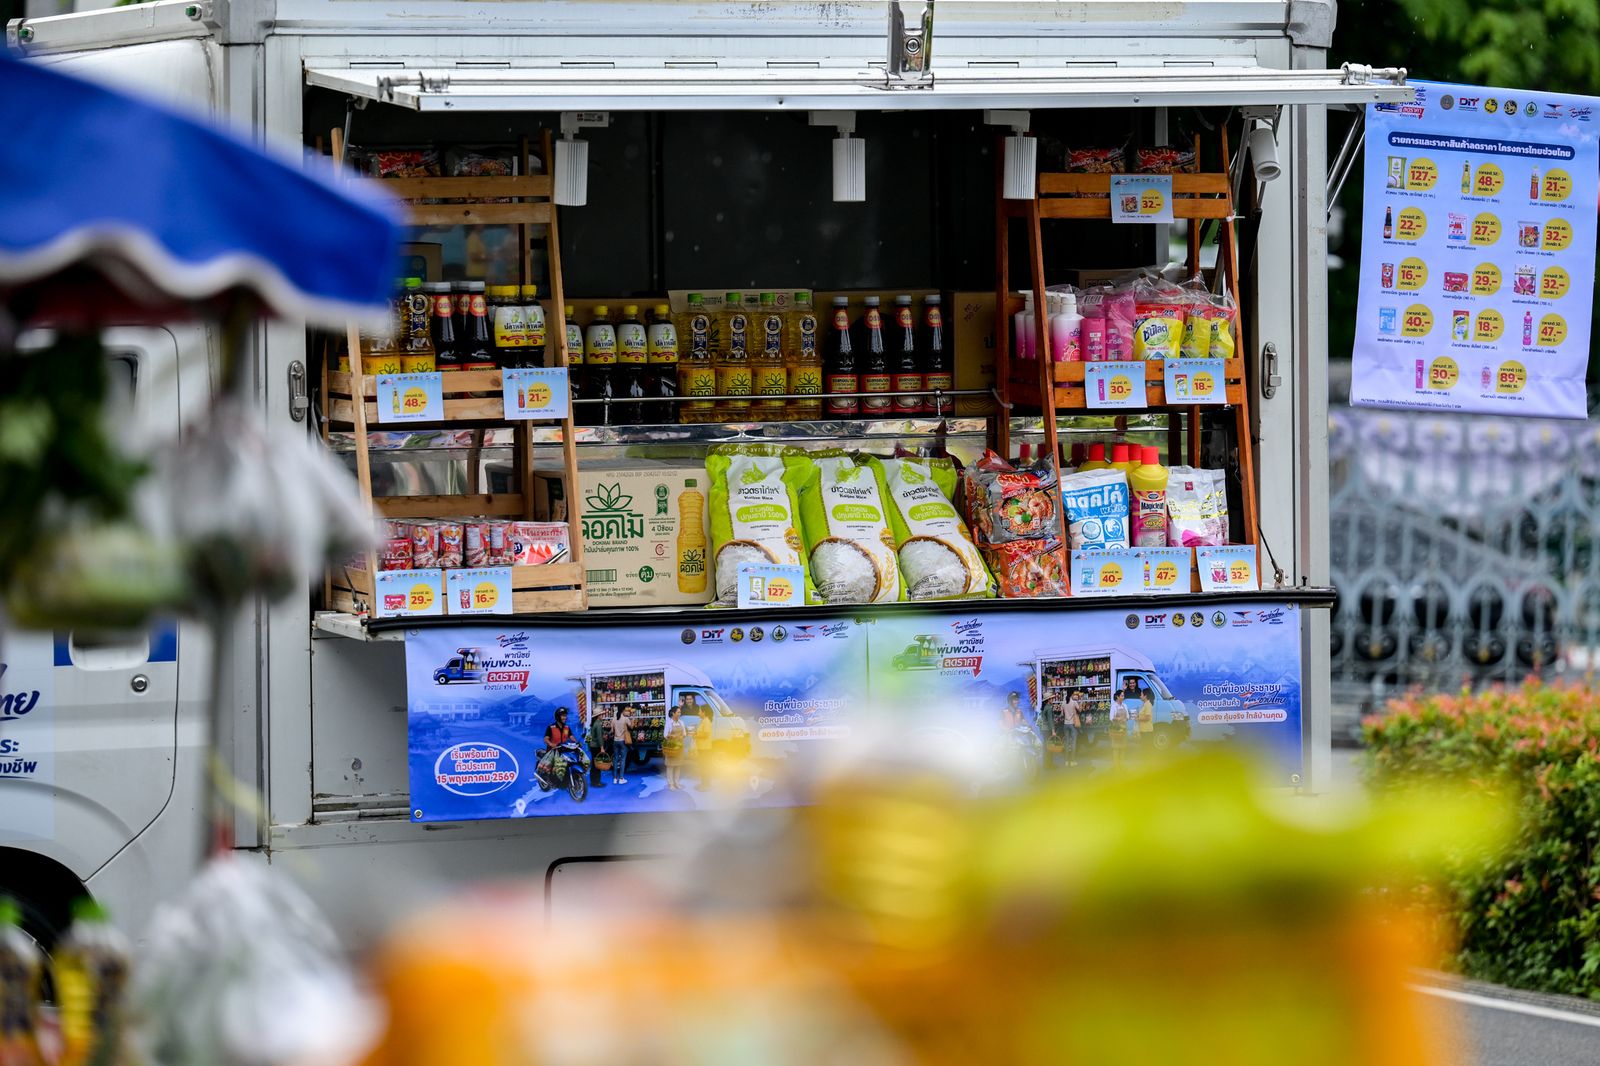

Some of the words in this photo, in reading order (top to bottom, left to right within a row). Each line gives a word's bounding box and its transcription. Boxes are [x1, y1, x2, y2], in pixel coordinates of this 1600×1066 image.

[1391, 136, 1497, 151] รายการและราคาสินค้าลดราคา
[1498, 143, 1571, 157] โครงการไทยช่วยไทย
[1411, 171, 1436, 181] 127.-
[1478, 176, 1500, 186] 48.-
[1546, 181, 1566, 192] 21.-
[1142, 200, 1161, 209] 32.-
[1400, 220, 1422, 230] 22.-
[1475, 226, 1496, 236] 27.-
[1546, 231, 1568, 241] 32.-
[1401, 270, 1422, 280] 16.-
[1475, 275, 1497, 285] 29.-
[1544, 279, 1565, 289] 32.-
[1406, 317, 1430, 327] 40.-
[1478, 321, 1498, 332] 18.-
[1541, 326, 1562, 336] 47.-
[1433, 369, 1456, 380] 30.-
[1500, 373, 1523, 383] 89.-
[1111, 385, 1131, 394] 30.-
[1194, 382, 1212, 390] 18.-
[404, 398, 426, 407] 48.-
[528, 393, 547, 402] 21.-
[1157, 572, 1175, 580] 47.-
[768, 588, 792, 596] 127.-
[411, 596, 432, 605] 29.-
[476, 594, 494, 603] 16.-
[959, 637, 984, 645] พาณิชย์
[504, 651, 530, 659] พาณิชย์
[944, 658, 978, 667] ลดราคา
[489, 673, 525, 681] ลดราคา
[1203, 680, 1281, 696] เชิญพี่น้องประชาชน
[1198, 697, 1240, 710] อุดหนุนสินค้า
[1224, 713, 1244, 722] คุ้มจริง
[1246, 712, 1283, 720] ใกล้บ้านคุณ
[452, 748, 498, 759] เริ่มพร้อมกัน
[0, 758, 37, 773] งชีพ
[456, 761, 495, 770] ทั่วประเทศ
[437, 775, 446, 783] 15
[449, 774, 490, 785] พฤษภาคม
[493, 773, 515, 781] 2569
